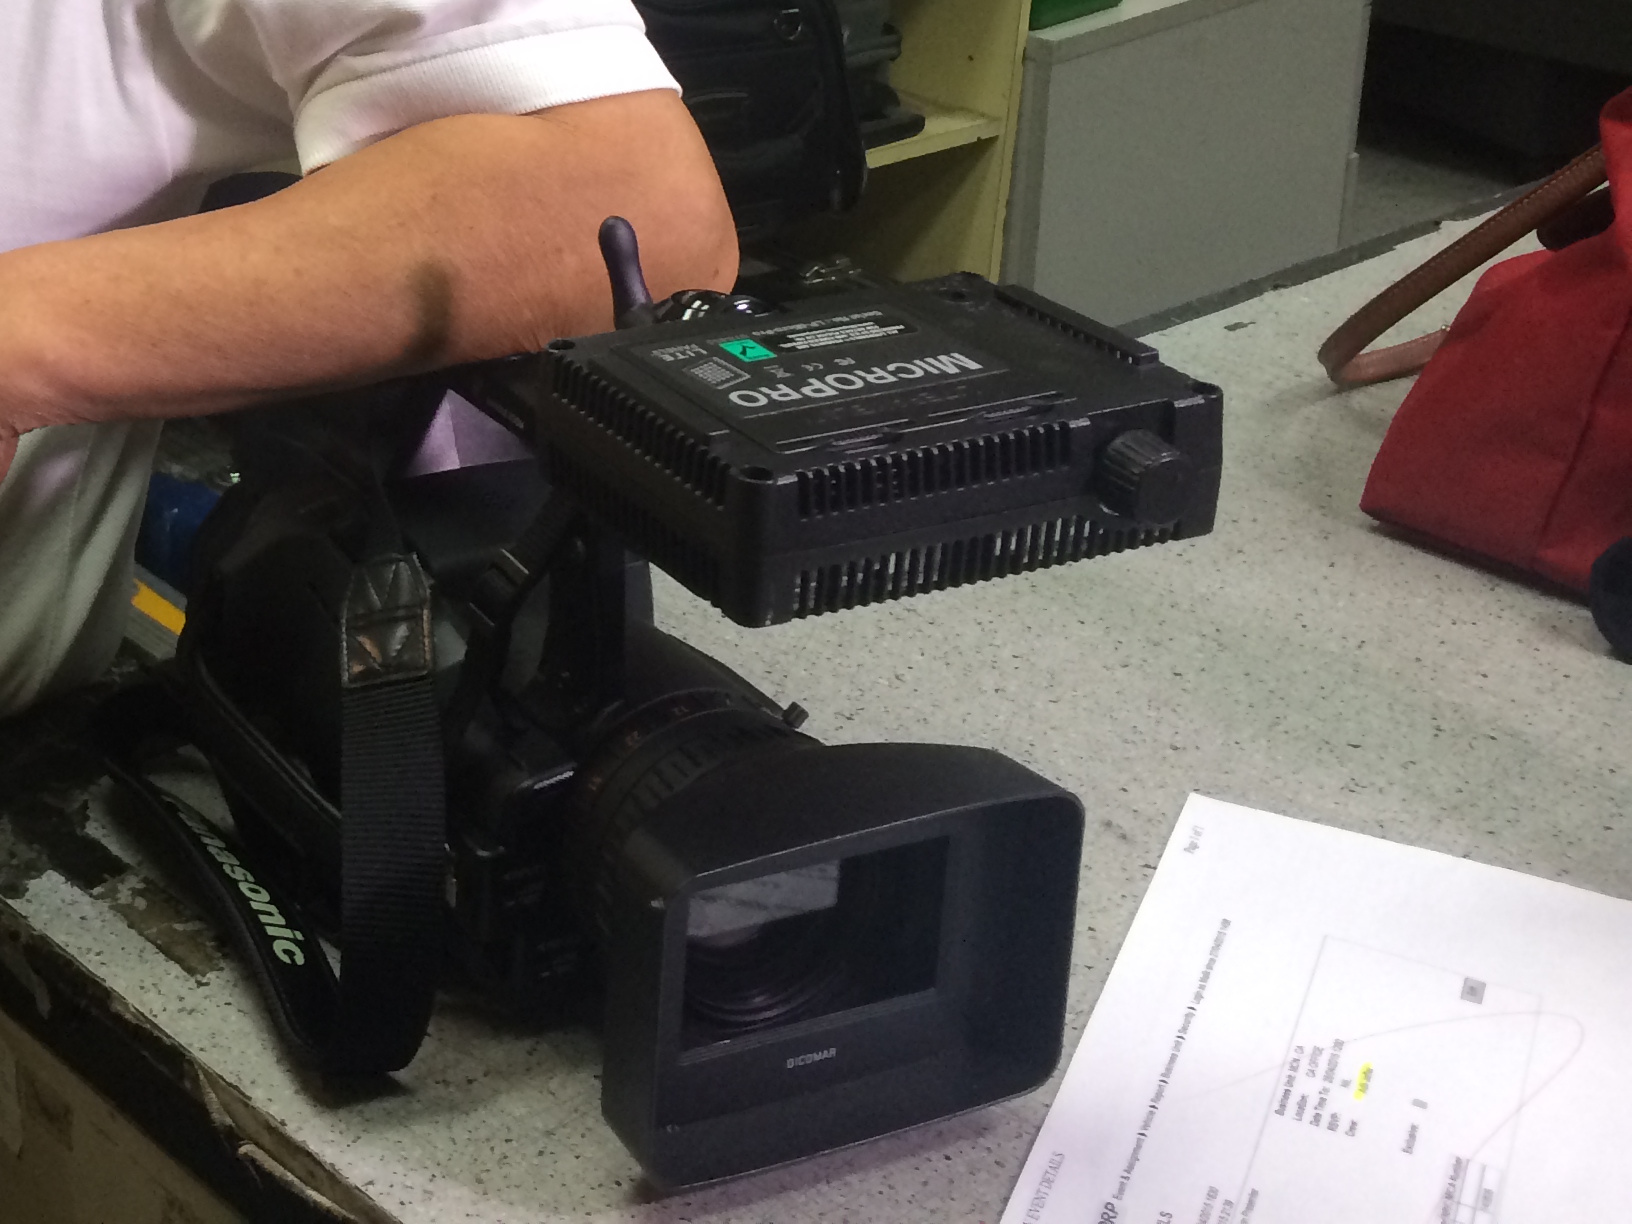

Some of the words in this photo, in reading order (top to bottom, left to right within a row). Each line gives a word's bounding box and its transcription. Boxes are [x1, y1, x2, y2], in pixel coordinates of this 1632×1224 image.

[728, 353, 983, 407] MICROPRO
[162, 794, 306, 966] nasonic
[1026, 1186, 1050, 1222] EVENT
[1039, 1150, 1066, 1191] DETAILS
